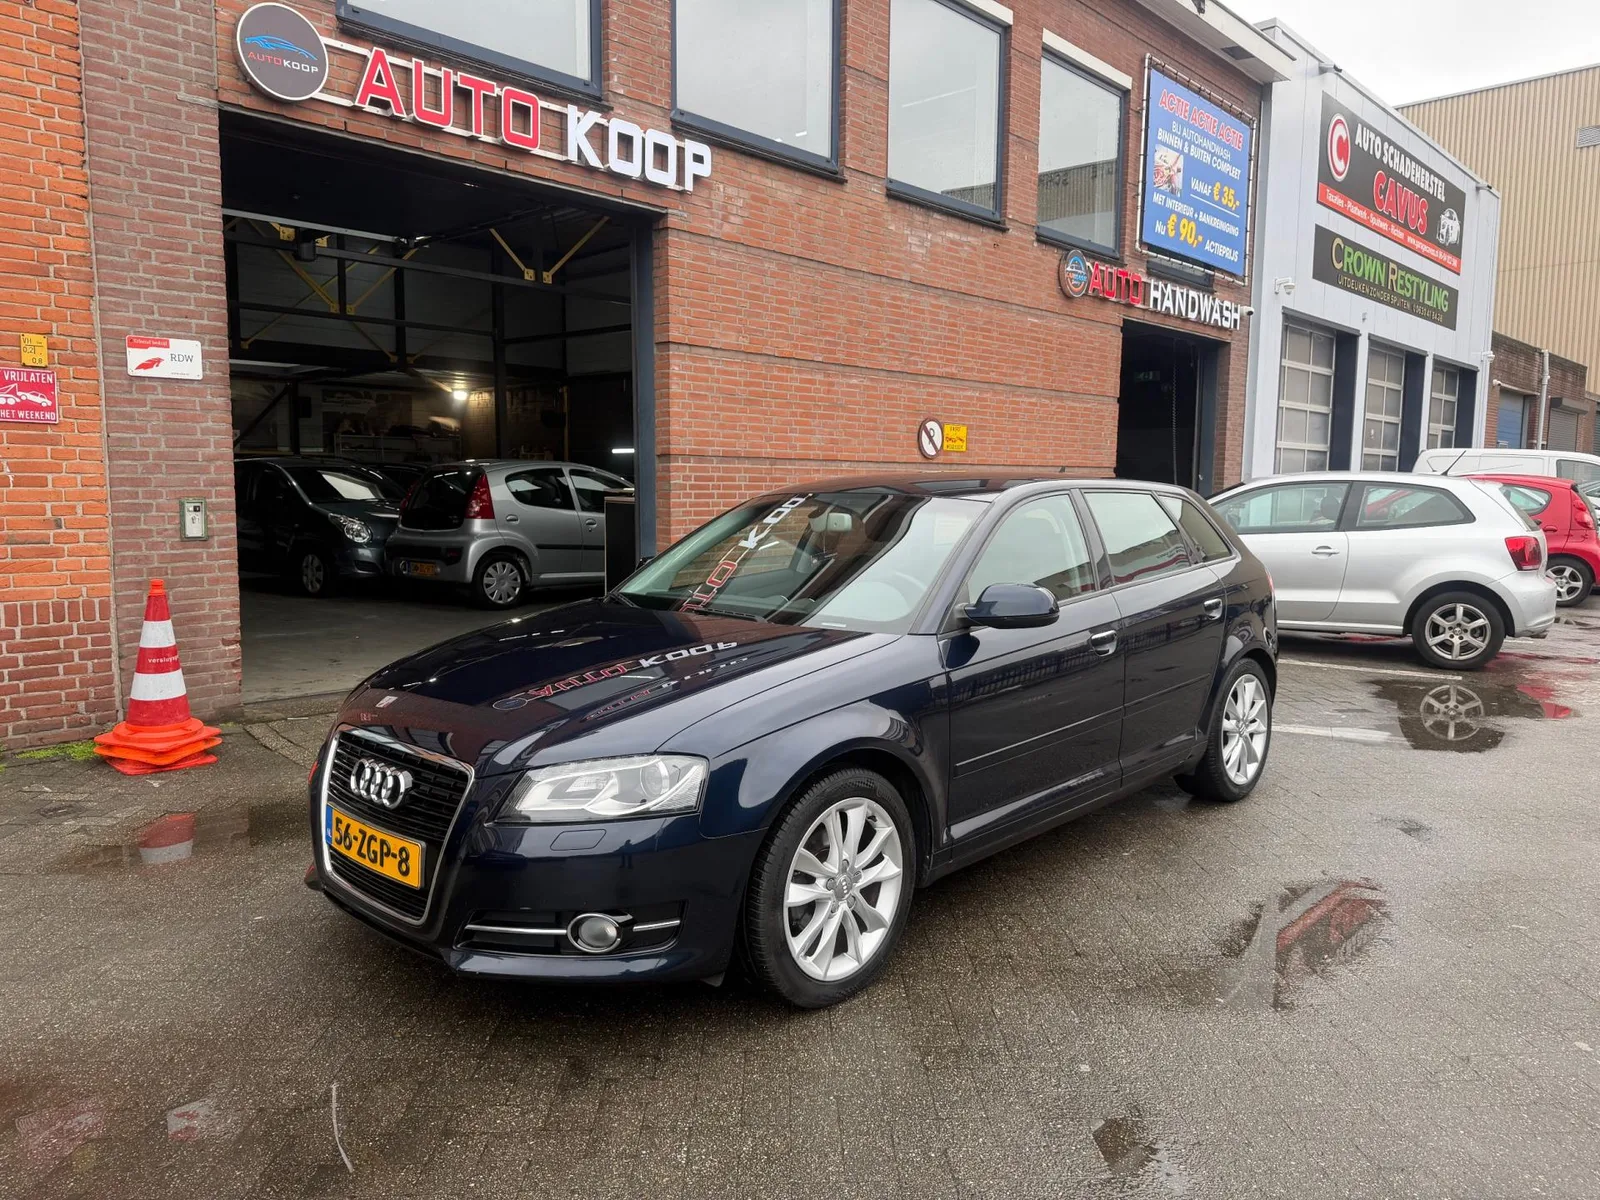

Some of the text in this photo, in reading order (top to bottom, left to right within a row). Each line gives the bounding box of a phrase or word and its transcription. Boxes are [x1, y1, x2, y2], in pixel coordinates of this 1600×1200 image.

[247, 50, 319, 75] AUTOKOOP
[354, 46, 712, 193] AUTO KOOP
[1159, 89, 1244, 151] ACTIE ACTIE ACTIE
[1182, 128, 1231, 161] AUTOHANDWASH
[1157, 127, 1182, 149] BINNEN
[1190, 145, 1212, 166] BUITEN
[1212, 156, 1242, 181] COMPLEET
[1355, 122, 1446, 202] AUTO SCHADEHERSTEL
[1152, 191, 1165, 208] MET
[1165, 197, 1194, 219] INTERIEUR
[1191, 176, 1212, 197] VANAF
[1373, 170, 1429, 235] CAVUS
[1204, 239, 1239, 262] ACTIEPRIJS
[1330, 237, 1387, 287] CROWN
[1388, 261, 1450, 313] RESTYLING
[1088, 261, 1241, 331] AUTO HANDWASH
[170, 353, 194, 363] RDW
[0, 409, 56, 421] HET WEEKEND
[334, 816, 411, 877] 56-ZGP-8
